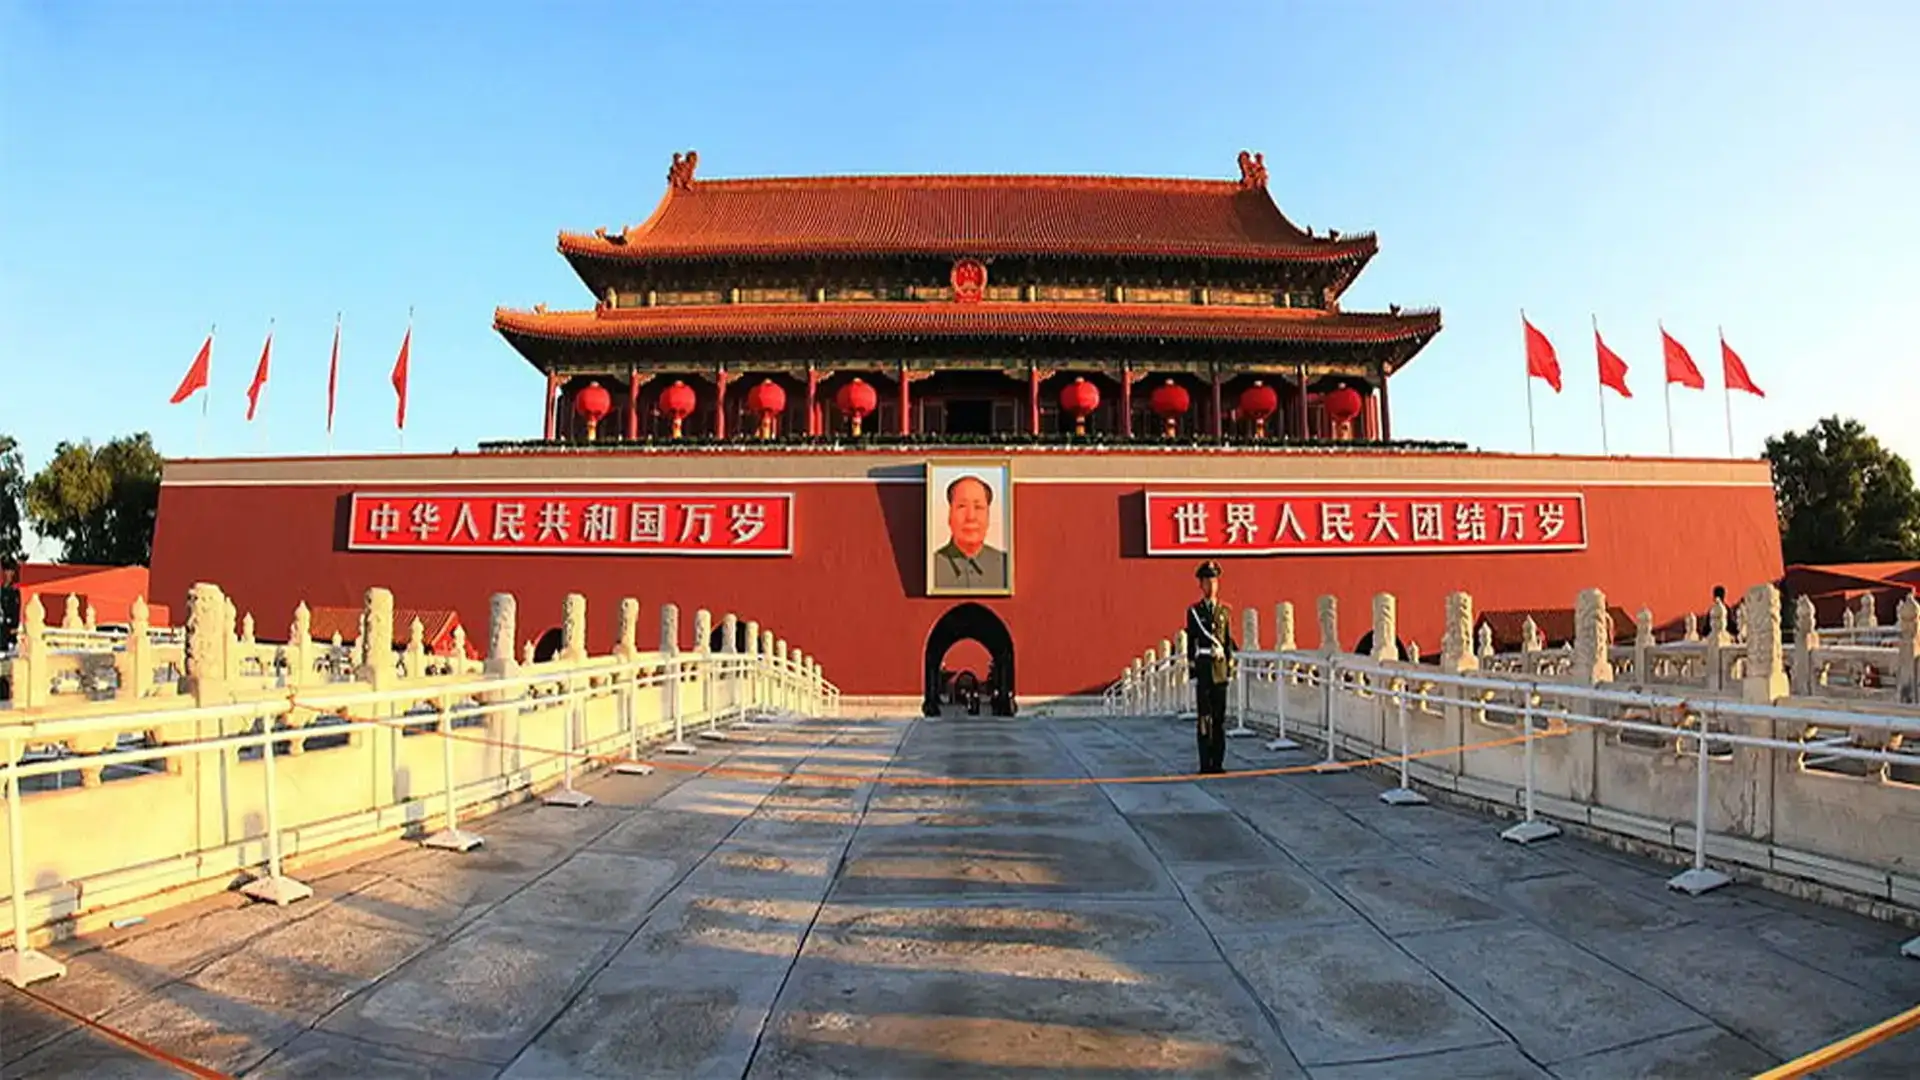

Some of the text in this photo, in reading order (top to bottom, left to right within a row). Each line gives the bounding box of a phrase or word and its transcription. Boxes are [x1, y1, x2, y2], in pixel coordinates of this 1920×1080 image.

[370, 502, 766, 544] 中华人民共和国万岁
[1174, 502, 1565, 544] 世界人民大团结万岁
